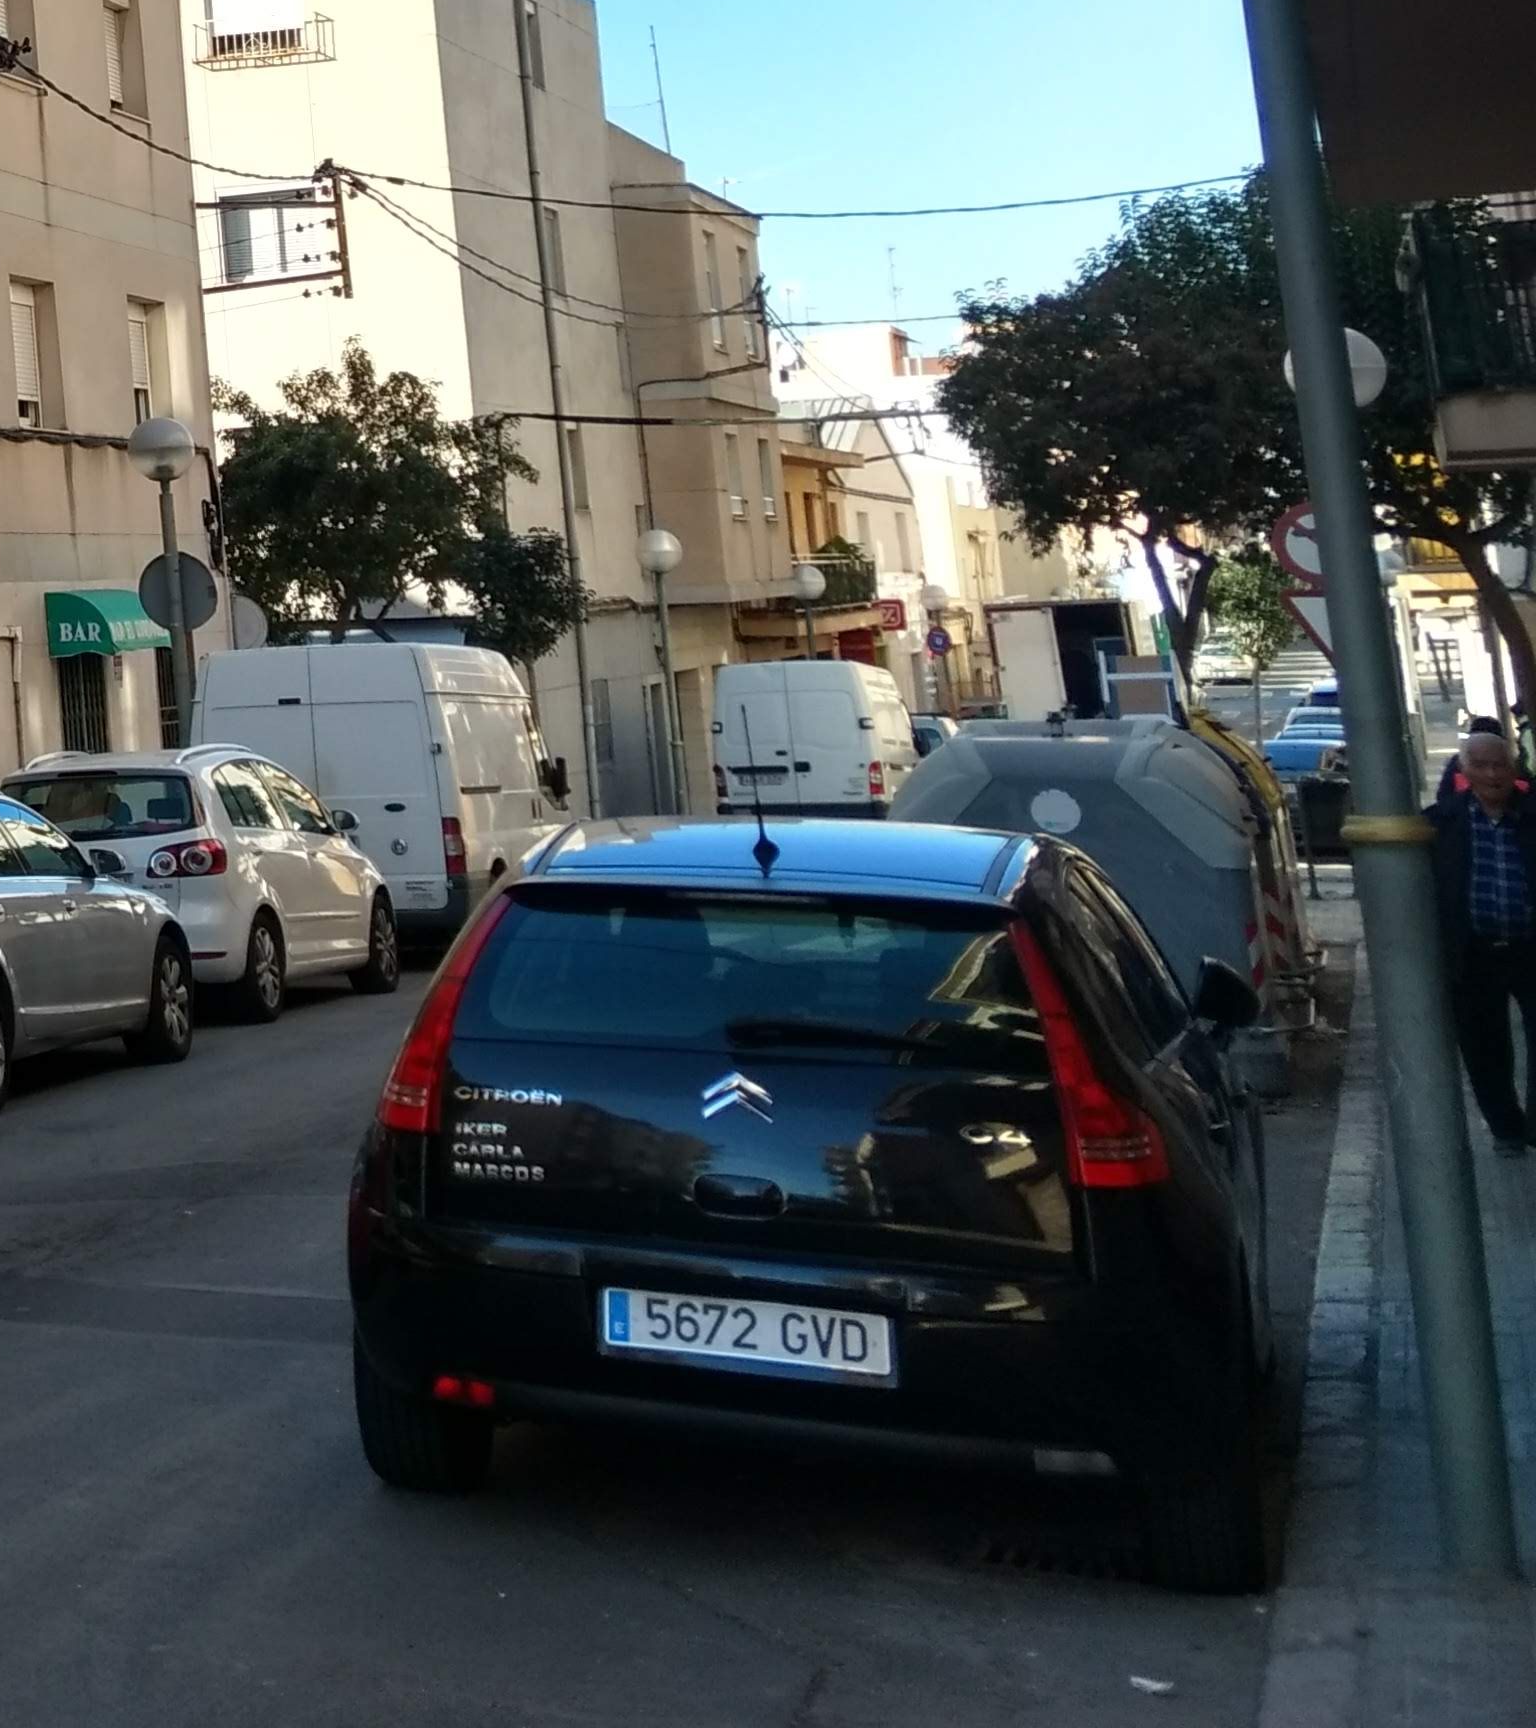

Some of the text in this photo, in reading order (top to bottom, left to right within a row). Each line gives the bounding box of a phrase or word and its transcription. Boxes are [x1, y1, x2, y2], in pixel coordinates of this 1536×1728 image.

[59, 618, 102, 643] BAR
[454, 1086, 562, 1106] CITROËN
[455, 1122, 508, 1135] IKER
[453, 1143, 525, 1159] CARLA
[453, 1161, 545, 1182] MARCOS
[645, 1297, 758, 1351] 5672
[780, 1312, 868, 1363] GVD
